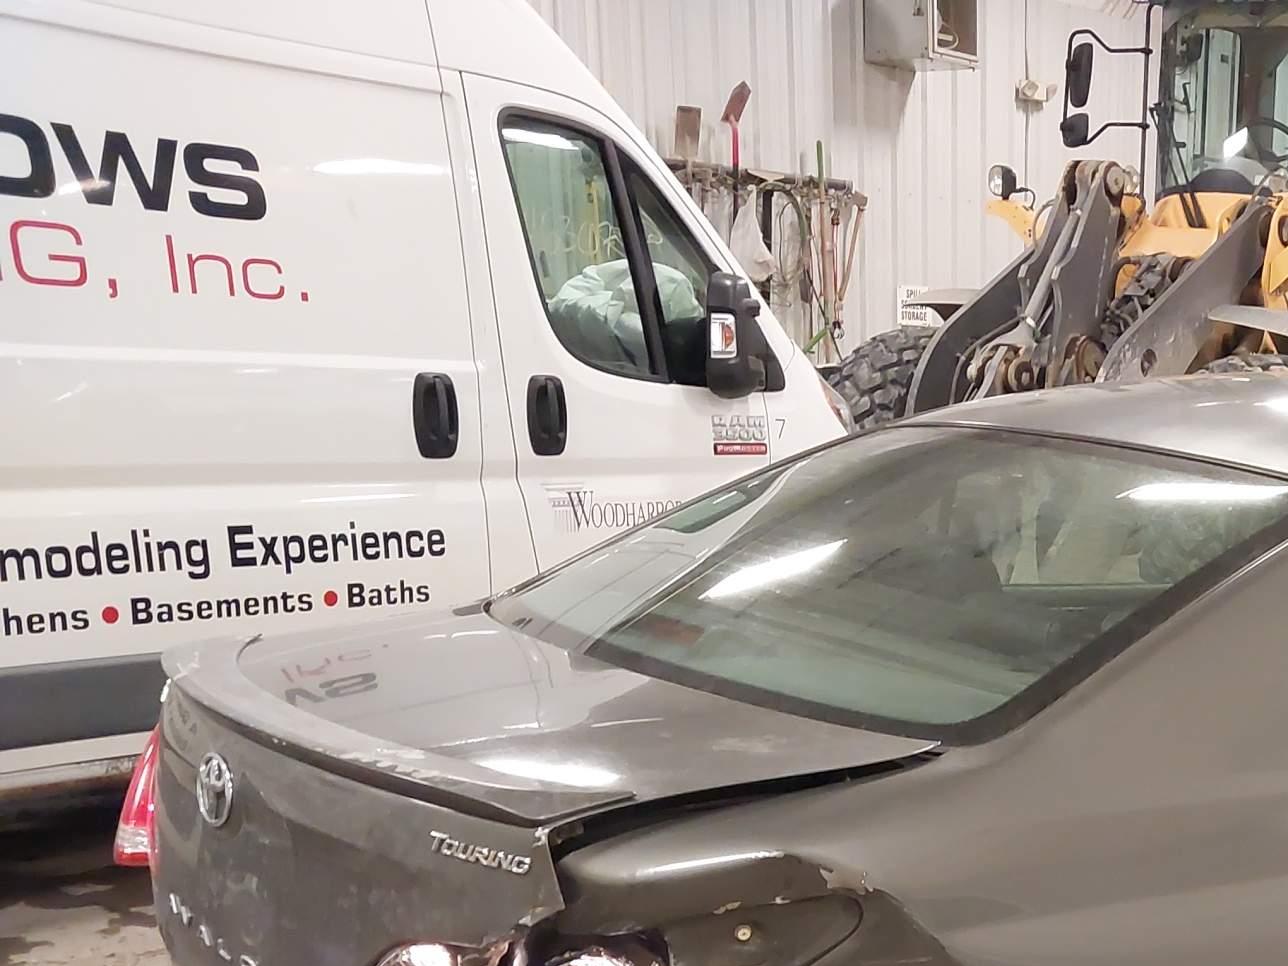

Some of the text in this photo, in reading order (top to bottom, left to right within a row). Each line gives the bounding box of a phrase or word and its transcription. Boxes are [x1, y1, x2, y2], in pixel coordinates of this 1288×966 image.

[0, 220, 309, 303] G, Inc.
[901, 310, 928, 321] STORAGE
[711, 415, 765, 428] RAM
[775, 418, 786, 440] 7
[566, 490, 683, 533] WOODHAR
[0, 521, 447, 580] modeling Experience
[3, 580, 431, 636] hens Basements Baths
[430, 830, 532, 874] TOURING
